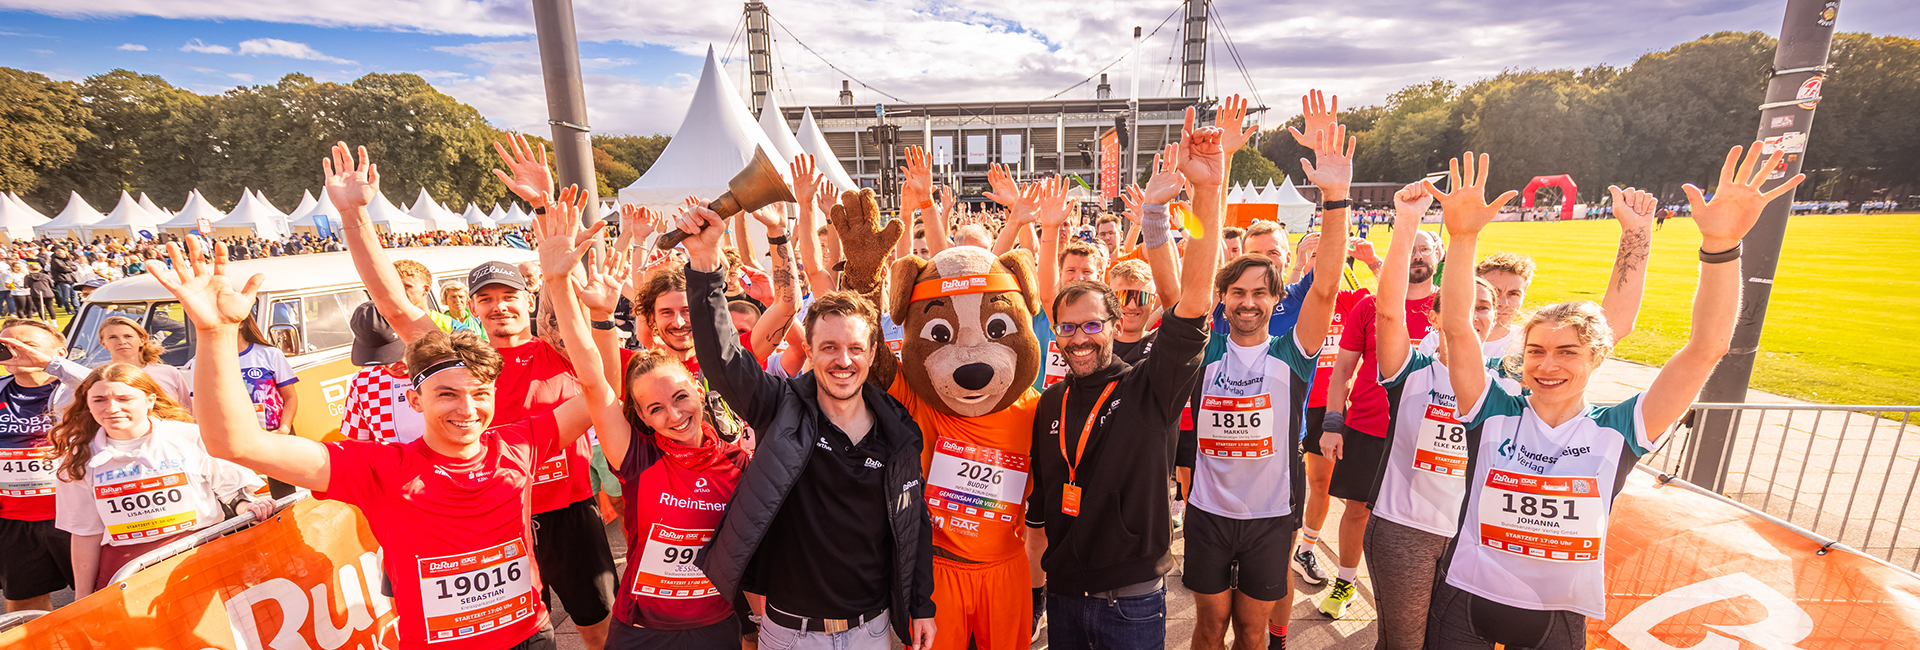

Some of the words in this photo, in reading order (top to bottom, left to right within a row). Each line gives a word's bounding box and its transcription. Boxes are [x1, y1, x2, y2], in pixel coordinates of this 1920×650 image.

[472, 265, 516, 284] Titleist
[1212, 412, 1262, 428] 1816
[1435, 424, 1464, 443] 18
[1433, 441, 1449, 450] ELKE
[555, 461, 562, 469] D
[1435, 456, 1461, 465] STARTZEIT
[1517, 452, 1545, 475] Verlag
[95, 464, 140, 484] TEAM
[957, 461, 1004, 485] 2026
[967, 480, 989, 490] BUDDY
[107, 488, 182, 514] 16060
[659, 492, 727, 511] RheinEner
[938, 490, 973, 504] GEMEINSAM
[972, 496, 984, 506] FÜR
[984, 499, 1008, 510] VIELFALT
[1502, 493, 1580, 521] 1851
[127, 506, 167, 518] LISA-MARIE
[950, 515, 980, 532] DAK
[1501, 521, 1541, 532] Bundesanzeiger
[1542, 527, 1560, 535] Verlag
[1517, 516, 1560, 528] JOHANNA
[1505, 532, 1539, 542] STARTZEIT
[1583, 540, 1593, 548] D
[663, 546, 702, 565] 99
[675, 565, 701, 573] JESSIC
[436, 562, 522, 600] 19016
[460, 588, 505, 605] SEBASTIAN
[460, 598, 496, 611] Kreissparkasse
[519, 595, 527, 605] D
[454, 611, 487, 623] STARTZEIT
[487, 606, 503, 615] 17:00
[503, 602, 514, 610] Uhr
